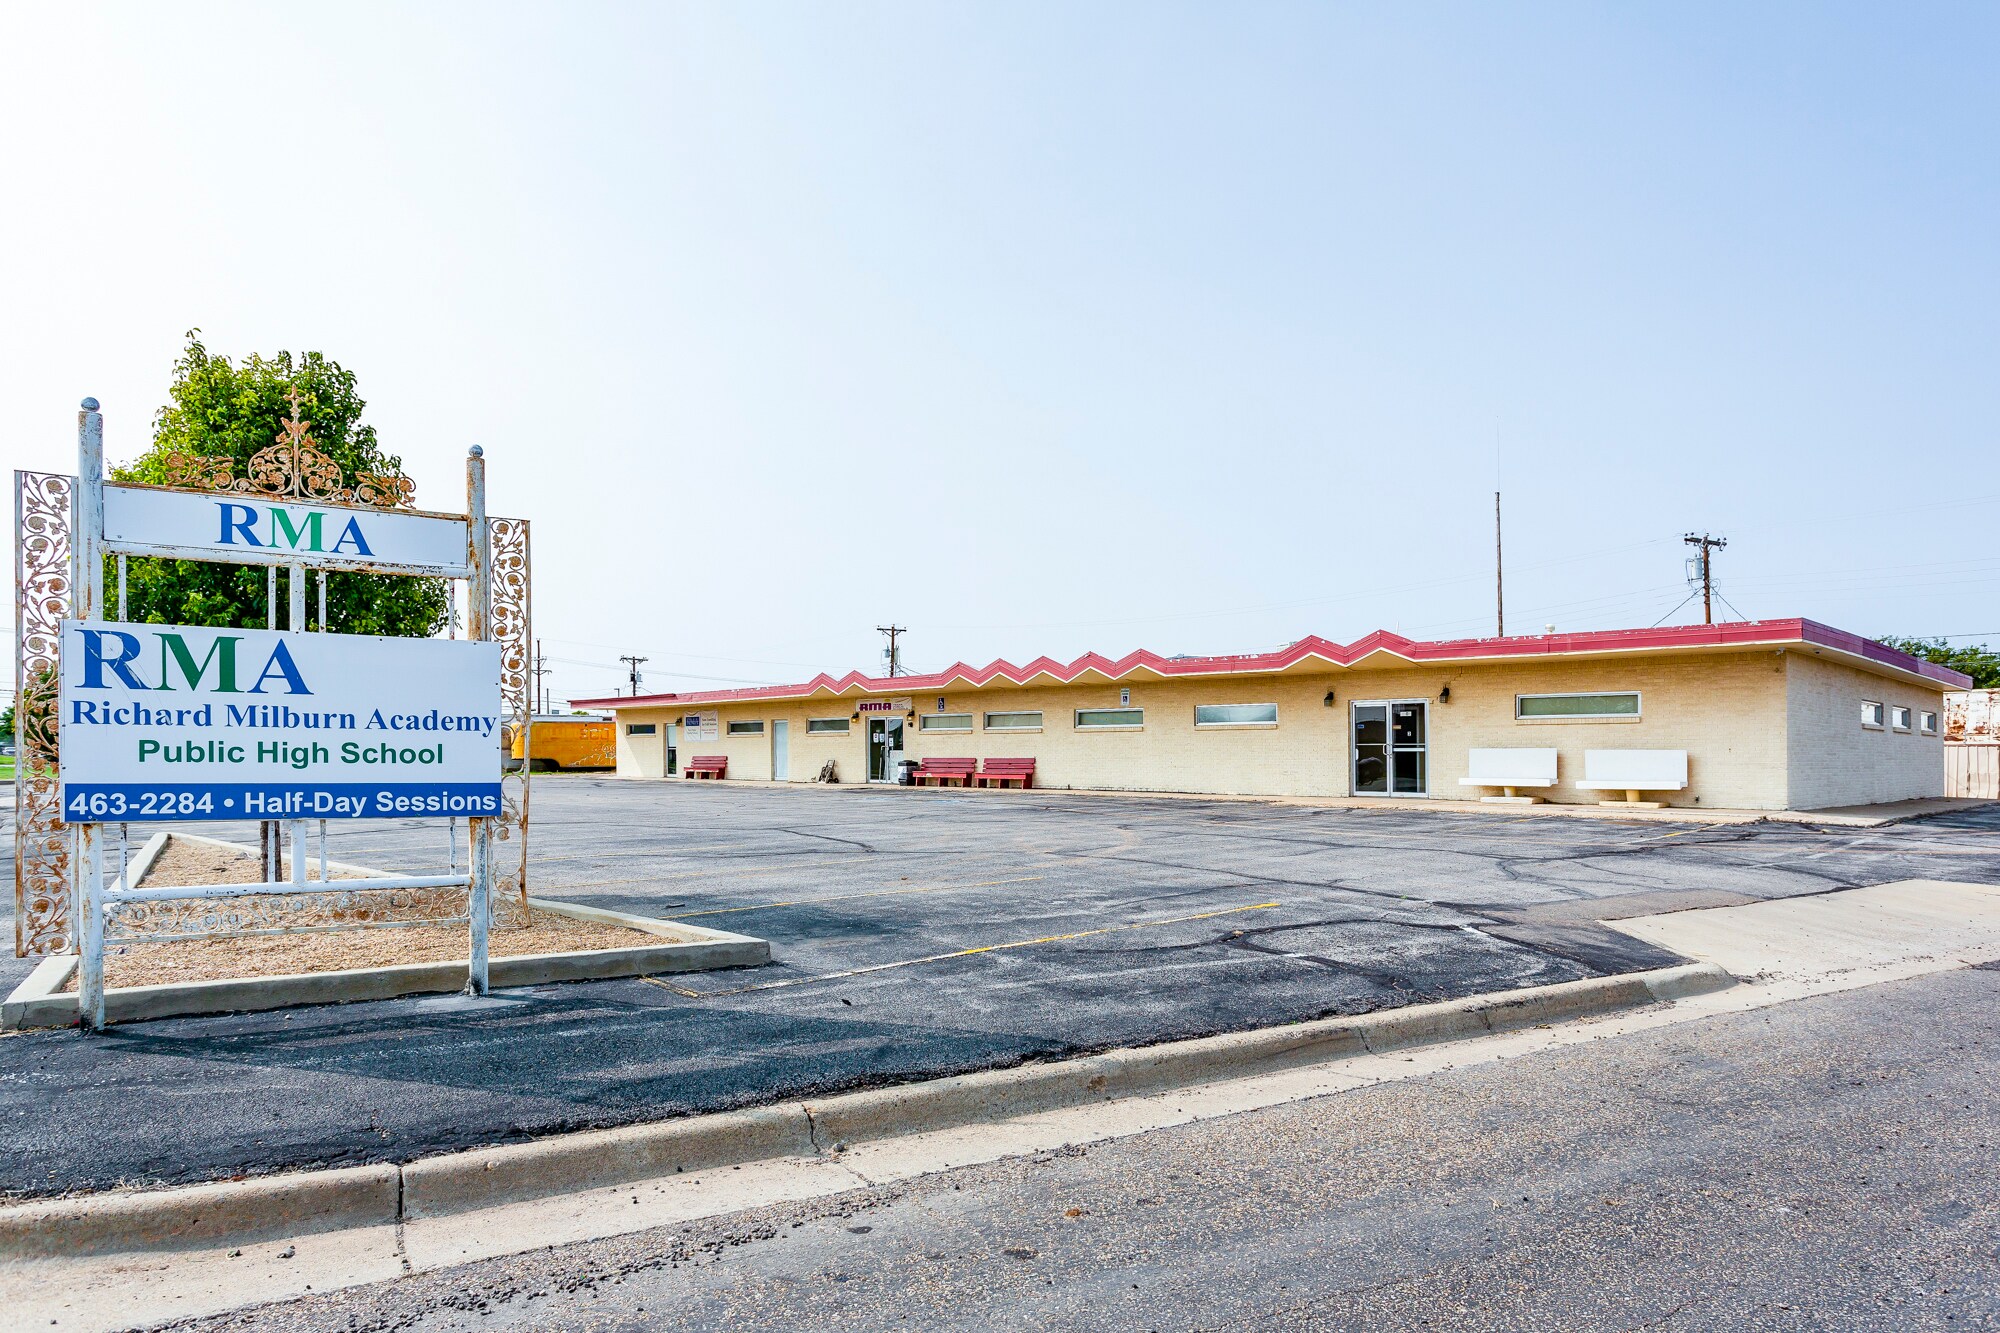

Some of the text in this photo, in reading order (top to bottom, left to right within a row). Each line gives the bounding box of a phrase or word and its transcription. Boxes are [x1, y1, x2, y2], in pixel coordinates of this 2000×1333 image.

[217, 503, 375, 556] RMA
[75, 629, 313, 695] RMA
[70, 701, 498, 738] Richard Milburn Academy
[138, 740, 442, 770] Public High School
[70, 790, 497, 818] 463-2284 Half-Day Sessions
